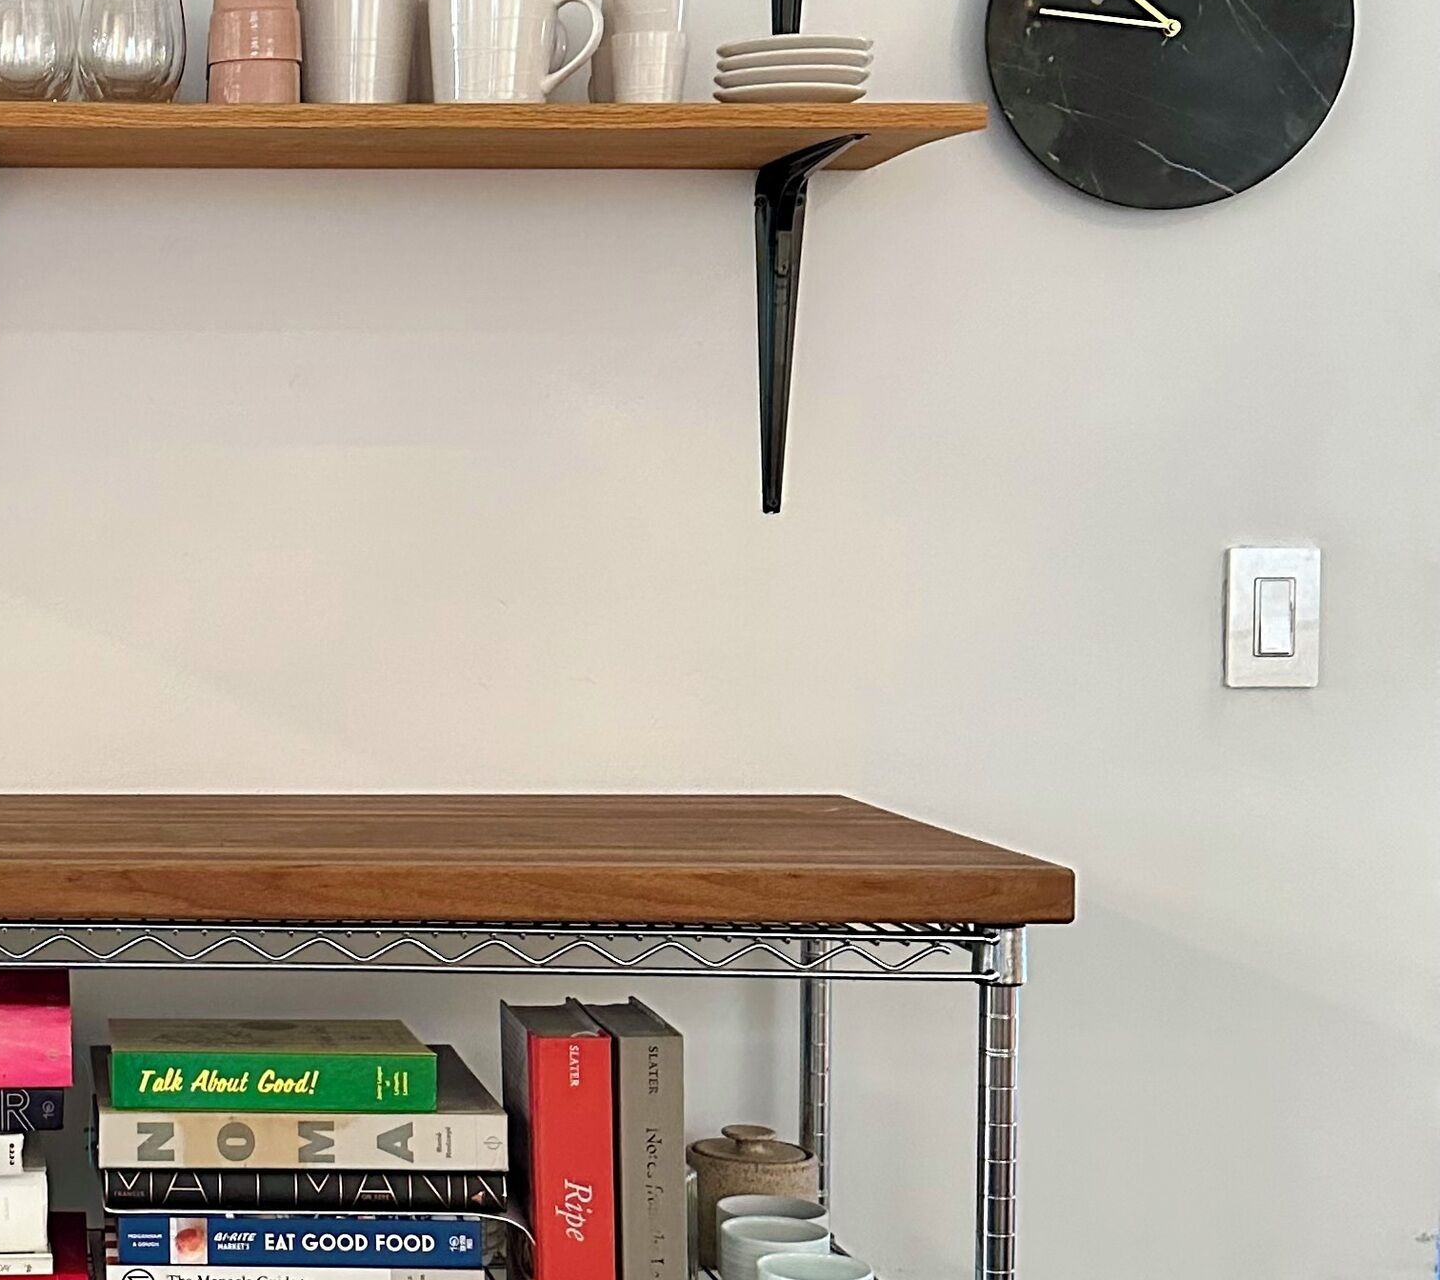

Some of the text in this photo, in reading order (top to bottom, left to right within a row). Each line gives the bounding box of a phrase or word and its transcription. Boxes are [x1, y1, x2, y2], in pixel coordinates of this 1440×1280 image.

[137, 1068, 320, 1096] Talk About Good!
[569, 1045, 580, 1087] SLATER
[648, 1045, 660, 1095] SLATER
[555, 1178, 594, 1243] Ripe
[213, 1232, 257, 1242] BI-RITE
[264, 1233, 436, 1253] EAT GOOD FOOD
